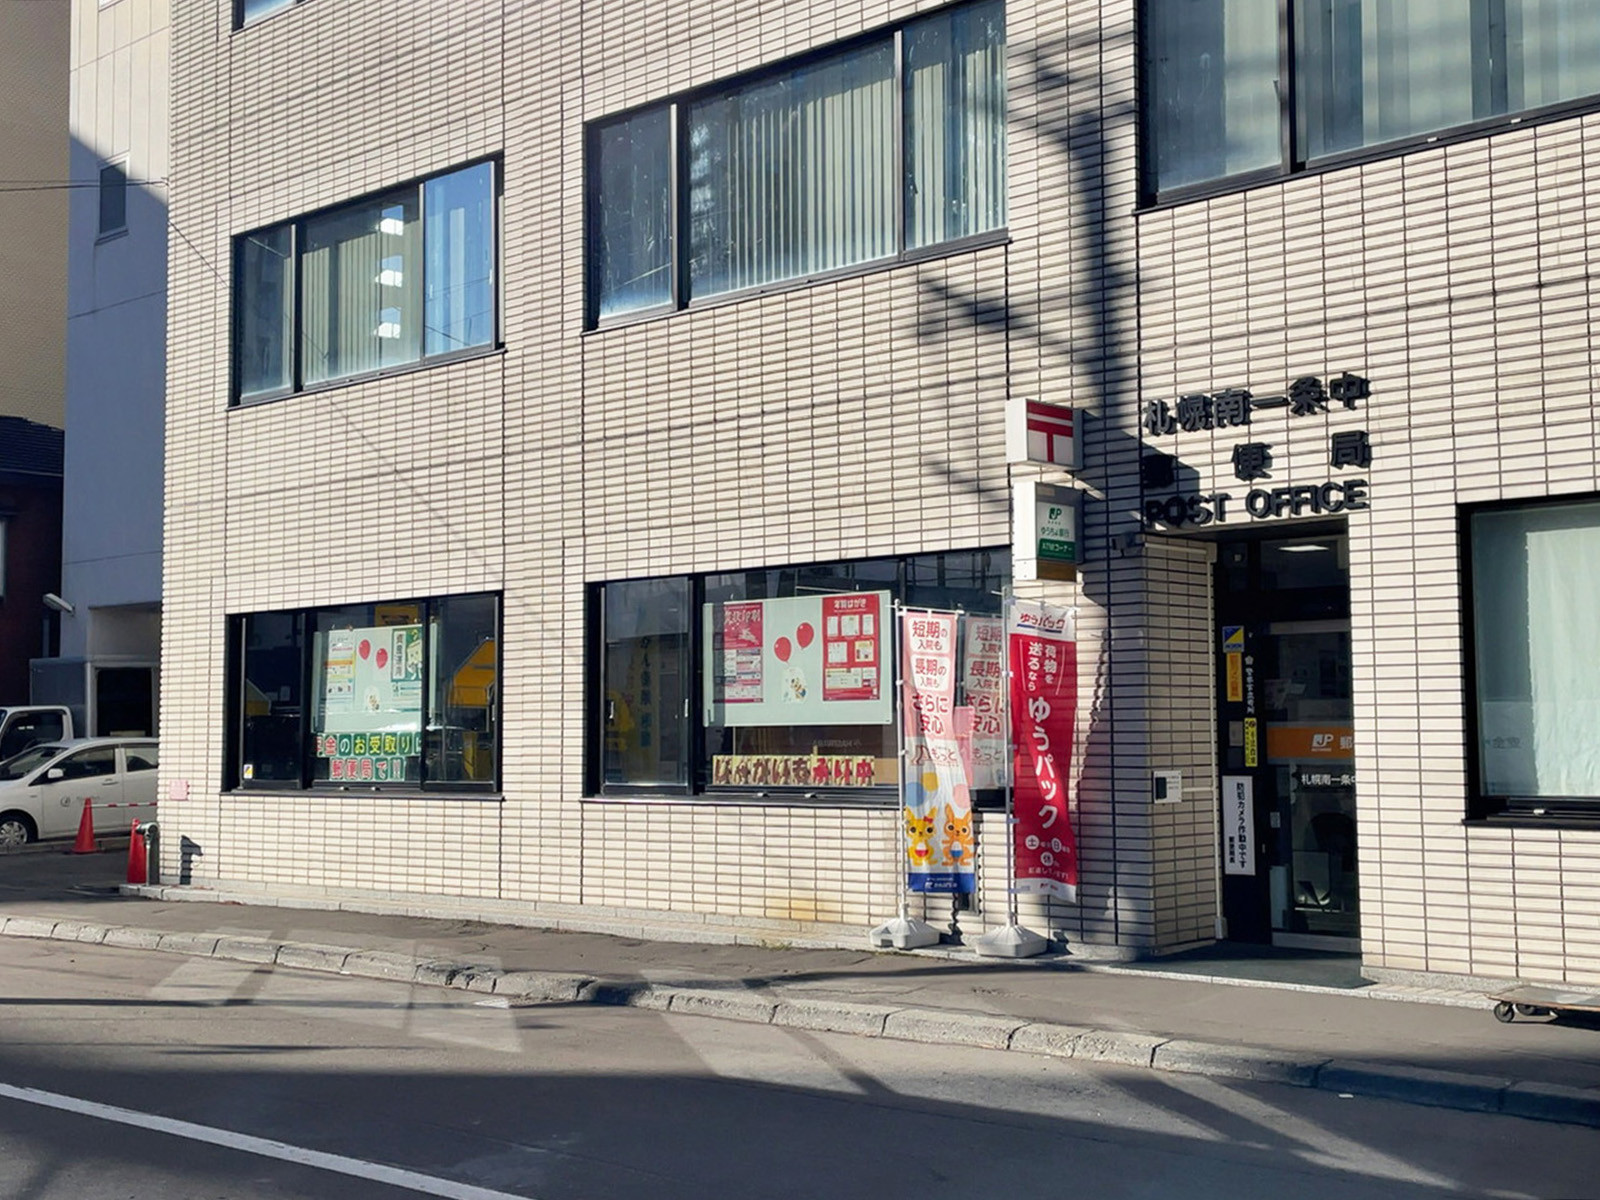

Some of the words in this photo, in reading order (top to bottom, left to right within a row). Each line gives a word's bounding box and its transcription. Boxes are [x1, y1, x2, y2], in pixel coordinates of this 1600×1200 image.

[1144, 372, 1371, 436] 札幌南一条中
[1146, 492, 1231, 526] POST
[1246, 479, 1371, 518] OFFICE
[912, 620, 947, 639] 短期の
[917, 640, 943, 650] 入院も
[914, 658, 946, 676] 長期の
[1028, 641, 1042, 692] 送るなら
[920, 676, 940, 688] 入院も
[912, 693, 948, 713] さらに
[920, 715, 944, 735] 安心
[1028, 696, 1058, 829] ゆうパック
